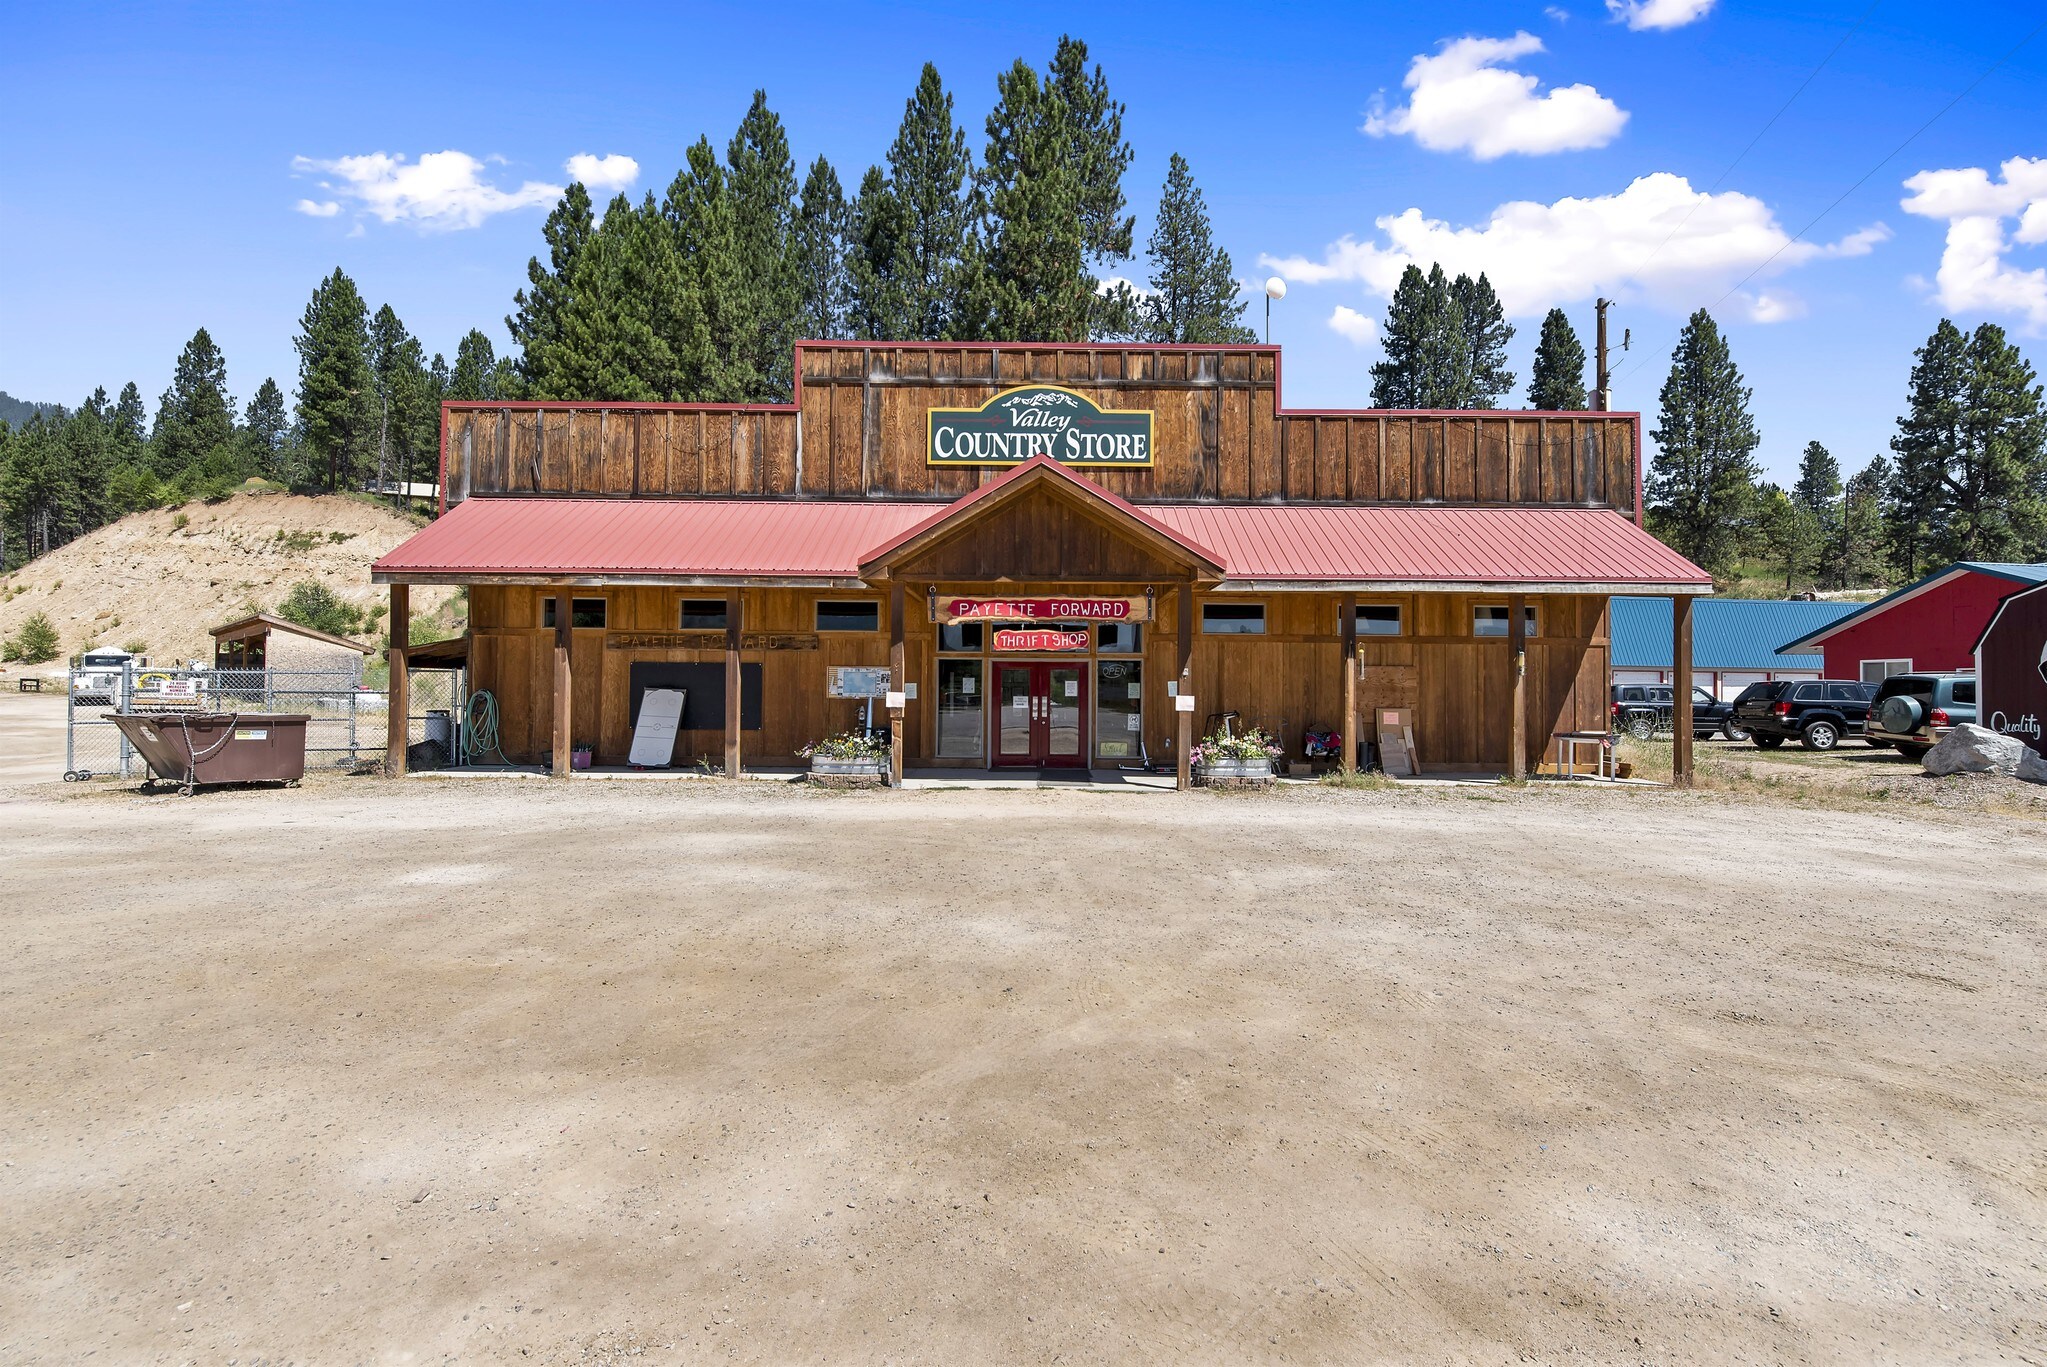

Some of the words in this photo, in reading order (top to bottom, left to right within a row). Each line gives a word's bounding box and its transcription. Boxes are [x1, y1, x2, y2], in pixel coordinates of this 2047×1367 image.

[1009, 407, 1071, 431] Valley
[934, 426, 1058, 459] COUNTRY
[1065, 427, 1147, 460] STORE
[959, 603, 1035, 617] PAYETTE
[1051, 603, 1124, 617] FORWARD
[621, 635, 686, 649] PAYETTE
[1102, 666, 1128, 677] OPEN
[1990, 711, 2040, 740] Quality
